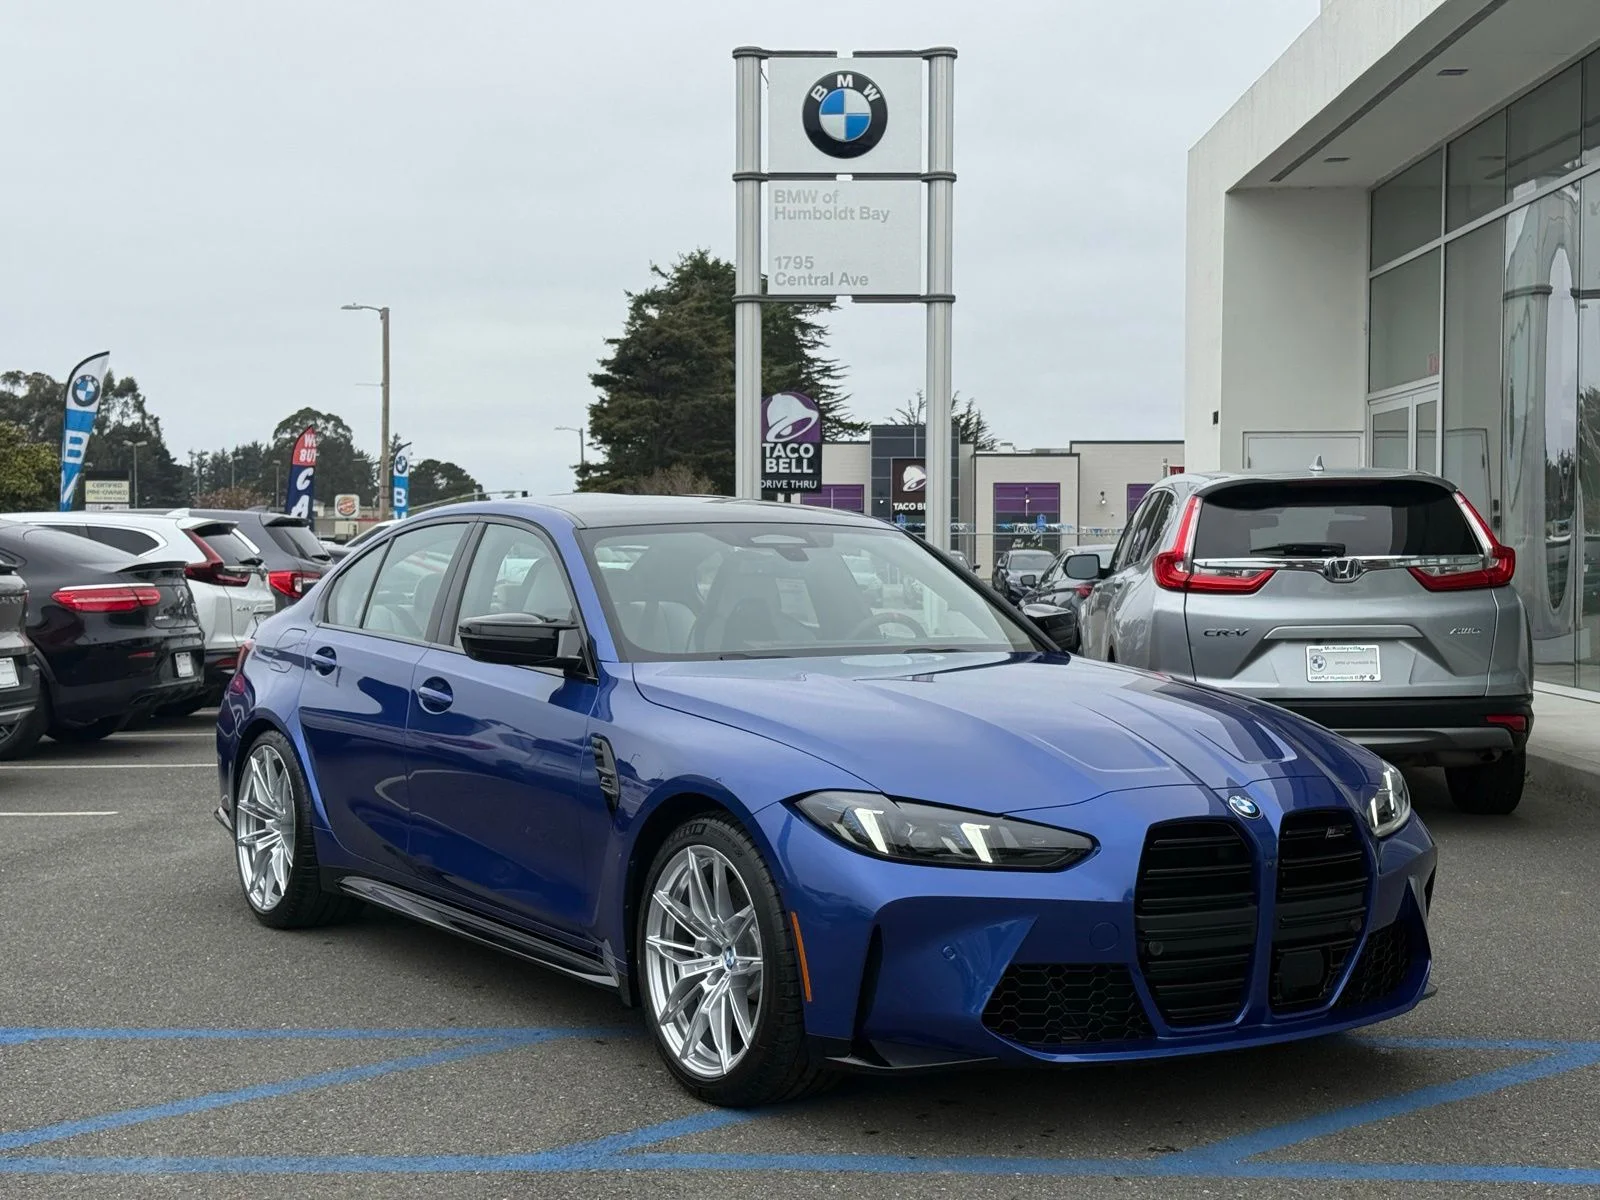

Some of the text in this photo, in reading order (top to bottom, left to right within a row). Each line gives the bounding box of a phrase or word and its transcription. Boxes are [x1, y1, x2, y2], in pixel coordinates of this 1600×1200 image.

[810, 74, 881, 102] BMW
[774, 189, 840, 204] BMW of
[774, 206, 890, 223] Humboldt Bay
[774, 256, 814, 270] 1795
[774, 272, 869, 286] Central Ave
[762, 443, 814, 458] TACO
[765, 458, 814, 473] BELL
[760, 480, 817, 489] DRIVE THRU
[892, 502, 917, 510] TACO
[1203, 629, 1249, 637] CR-V
